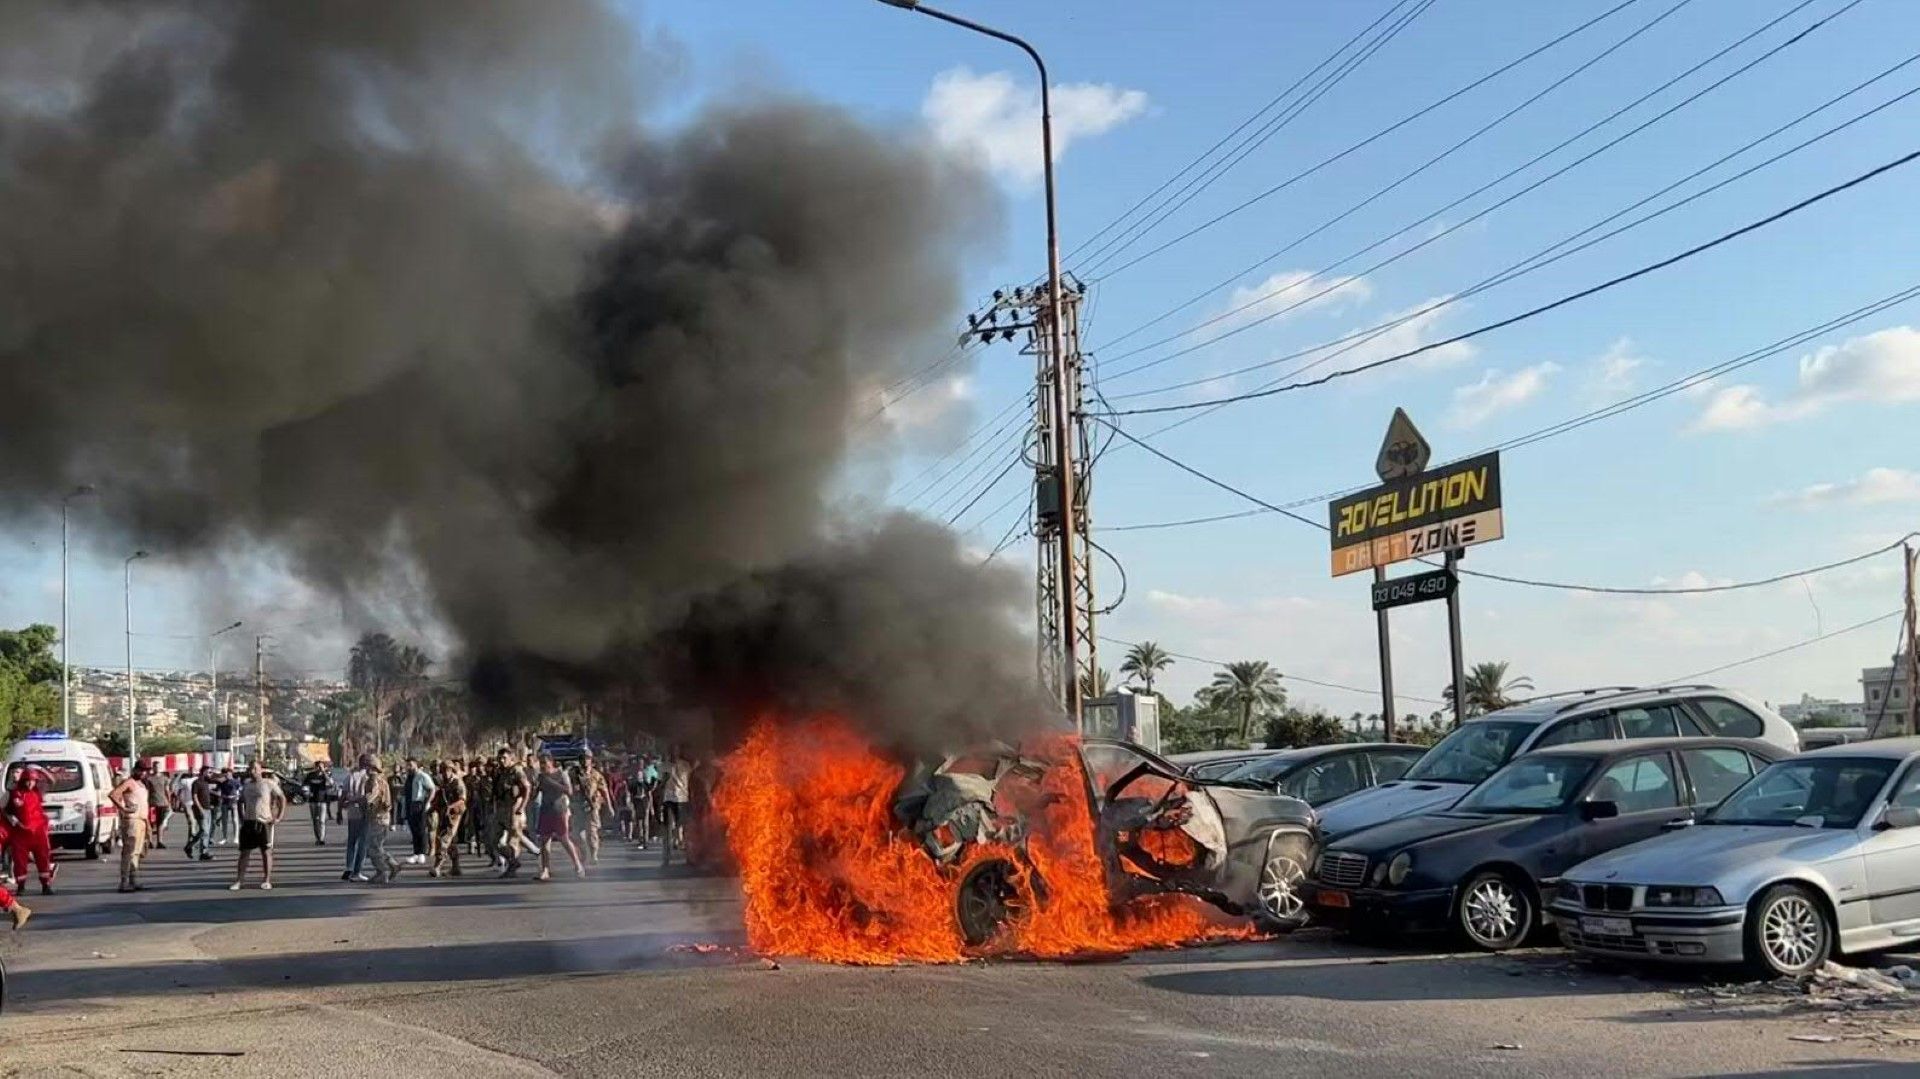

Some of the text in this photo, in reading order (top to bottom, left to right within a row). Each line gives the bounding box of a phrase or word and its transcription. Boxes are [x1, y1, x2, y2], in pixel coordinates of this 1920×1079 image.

[1337, 467, 1488, 537] ROVELUTION
[1411, 520, 1476, 554] ZONE
[1374, 587, 1389, 603] 03
